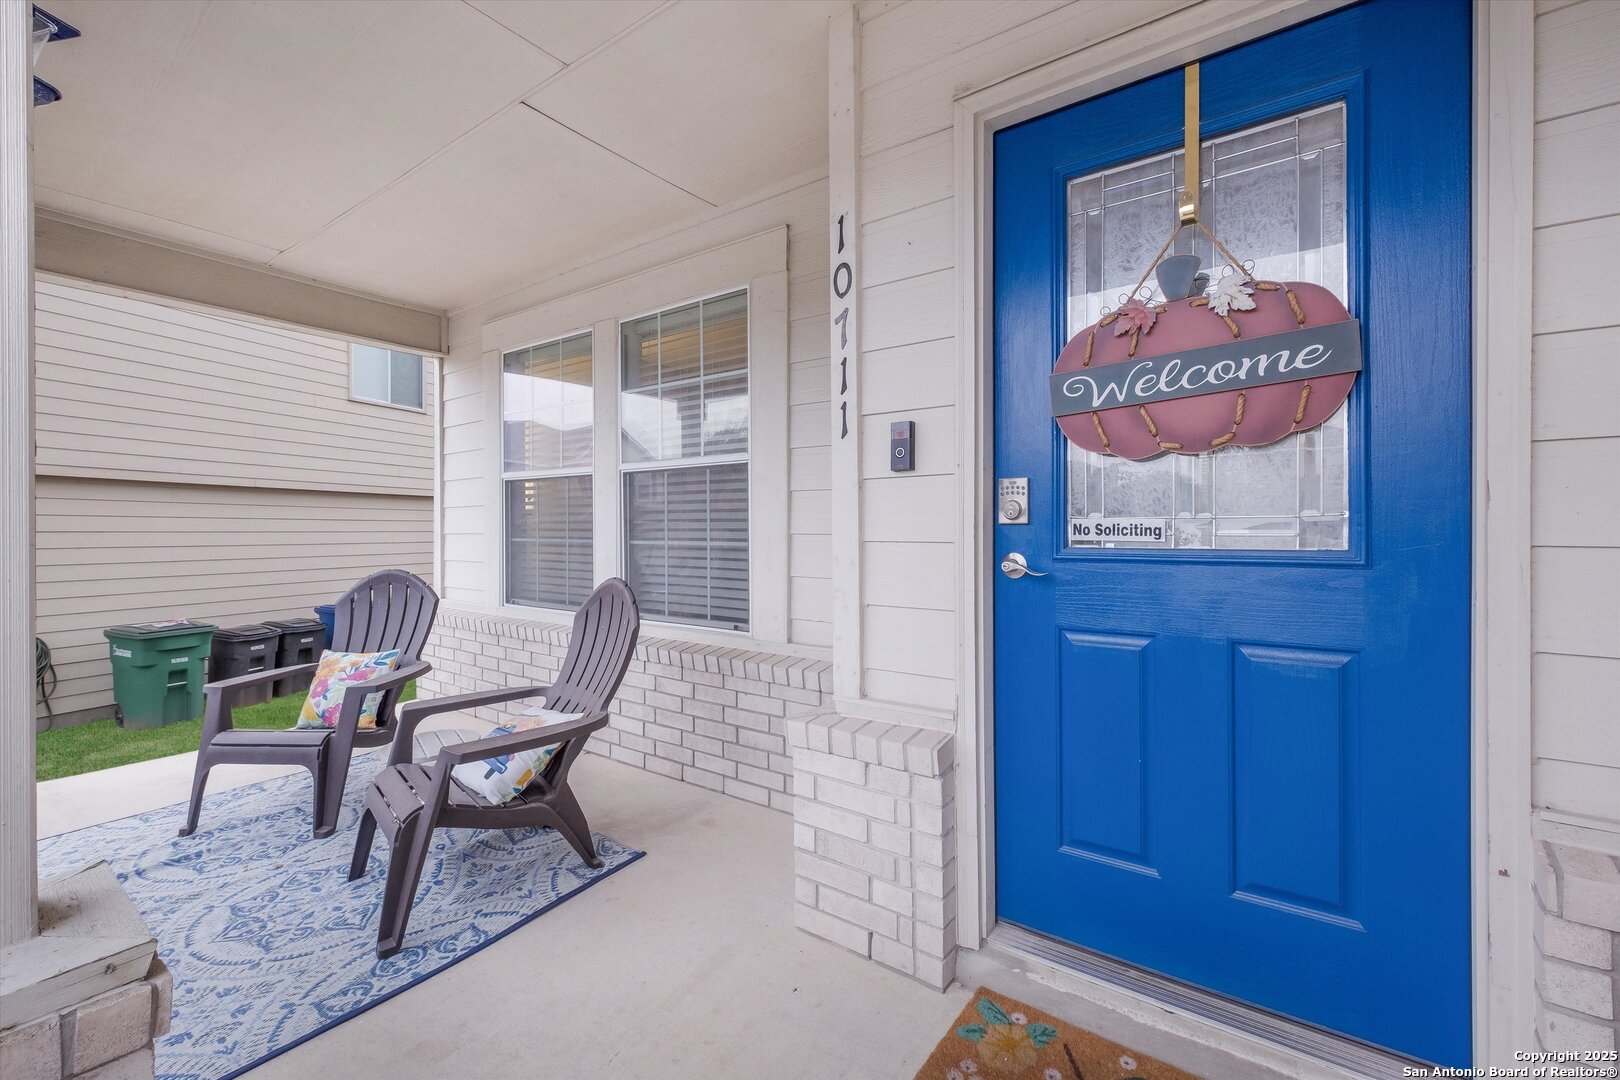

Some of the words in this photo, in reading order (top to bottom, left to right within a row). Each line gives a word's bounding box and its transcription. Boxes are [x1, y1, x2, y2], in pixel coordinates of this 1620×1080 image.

[833, 214, 853, 440] 10711
[1063, 344, 1333, 408] Welcome
[1072, 523, 1091, 536] No
[1094, 523, 1162, 540] Soliciting
